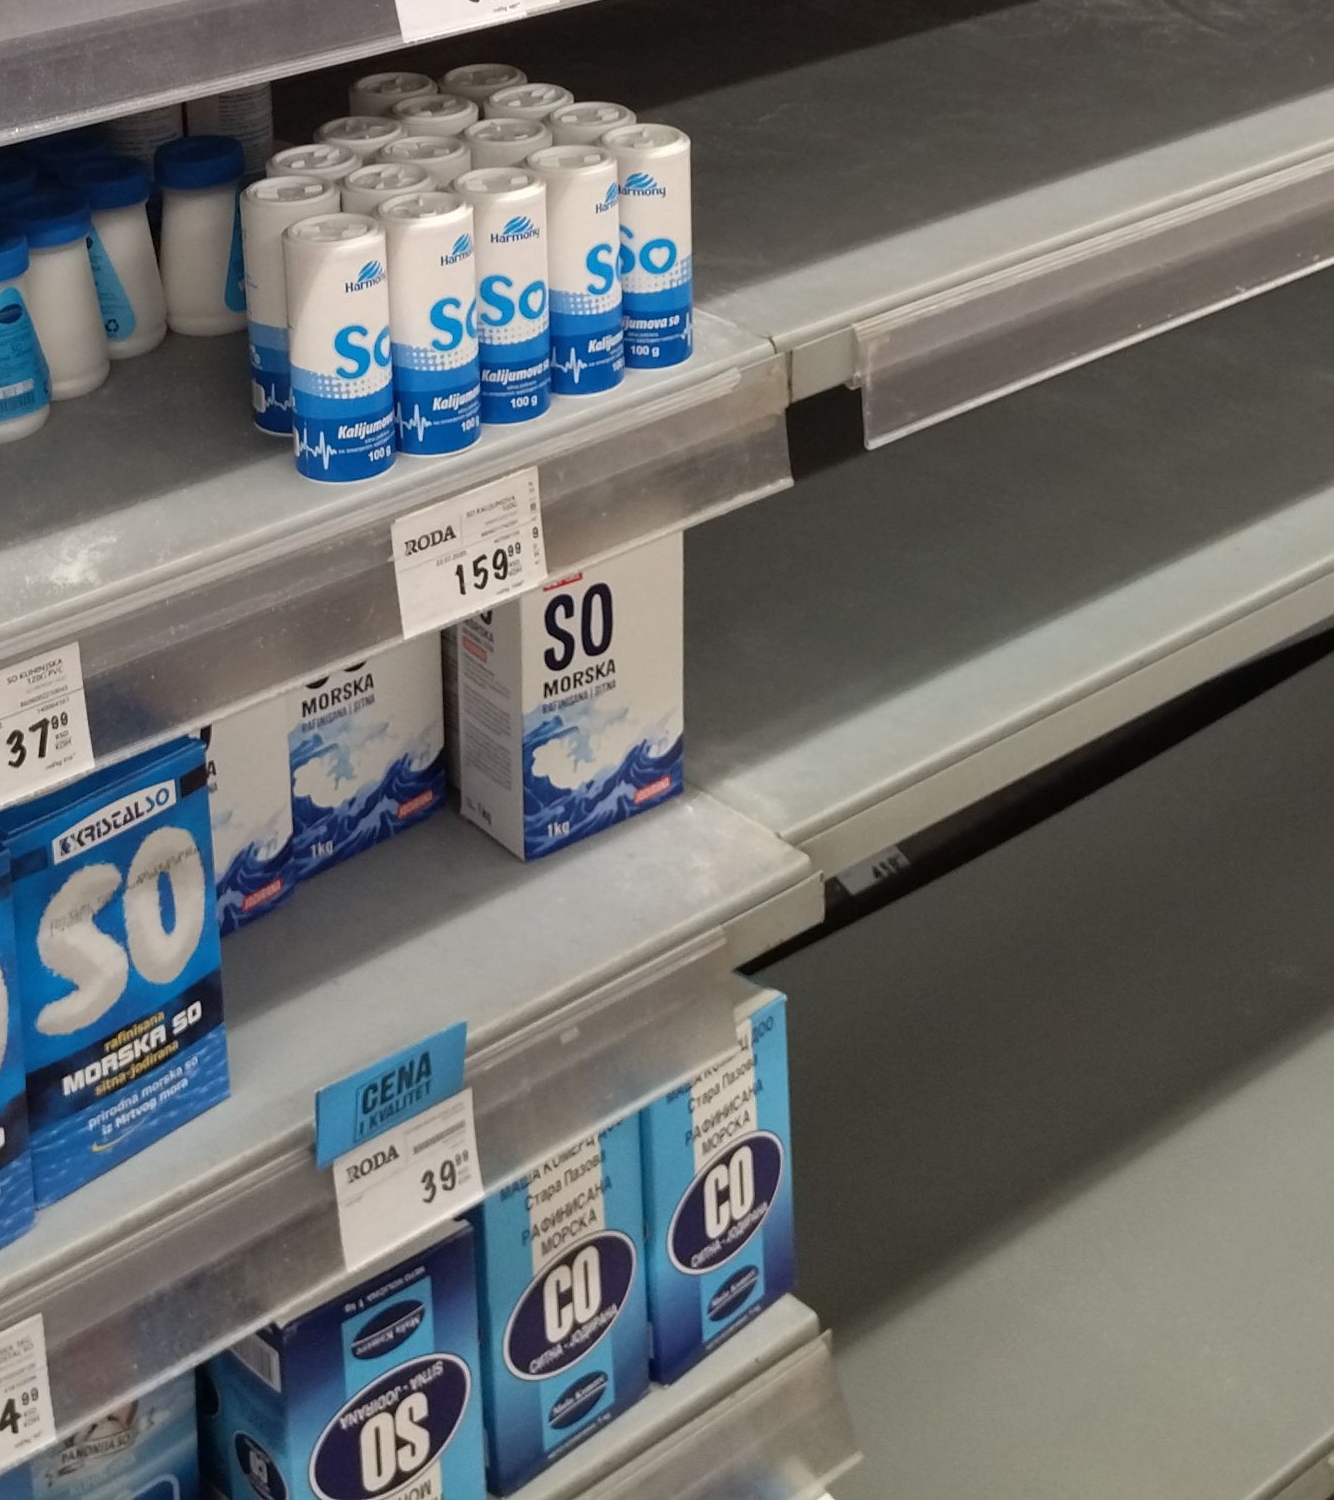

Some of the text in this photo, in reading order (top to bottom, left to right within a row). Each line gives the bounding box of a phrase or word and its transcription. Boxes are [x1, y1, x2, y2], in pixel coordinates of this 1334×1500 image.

[491, 225, 540, 244] Harmony
[511, 397, 528, 409] 100
[368, 449, 383, 462] 100
[404, 525, 457, 556] RODA
[455, 549, 508, 595] 159
[544, 582, 614, 672] SO
[302, 673, 375, 717] MORSKA
[544, 659, 617, 700] MORSKA
[6, 717, 50, 769] 37
[36, 825, 207, 1036] SO
[62, 1001, 204, 1097] MORSKA SO
[104, 1010, 166, 1054] rafinisana
[361, 1051, 432, 1115] CENA
[345, 1144, 400, 1184] RODA
[359, 1390, 432, 1494] SO
